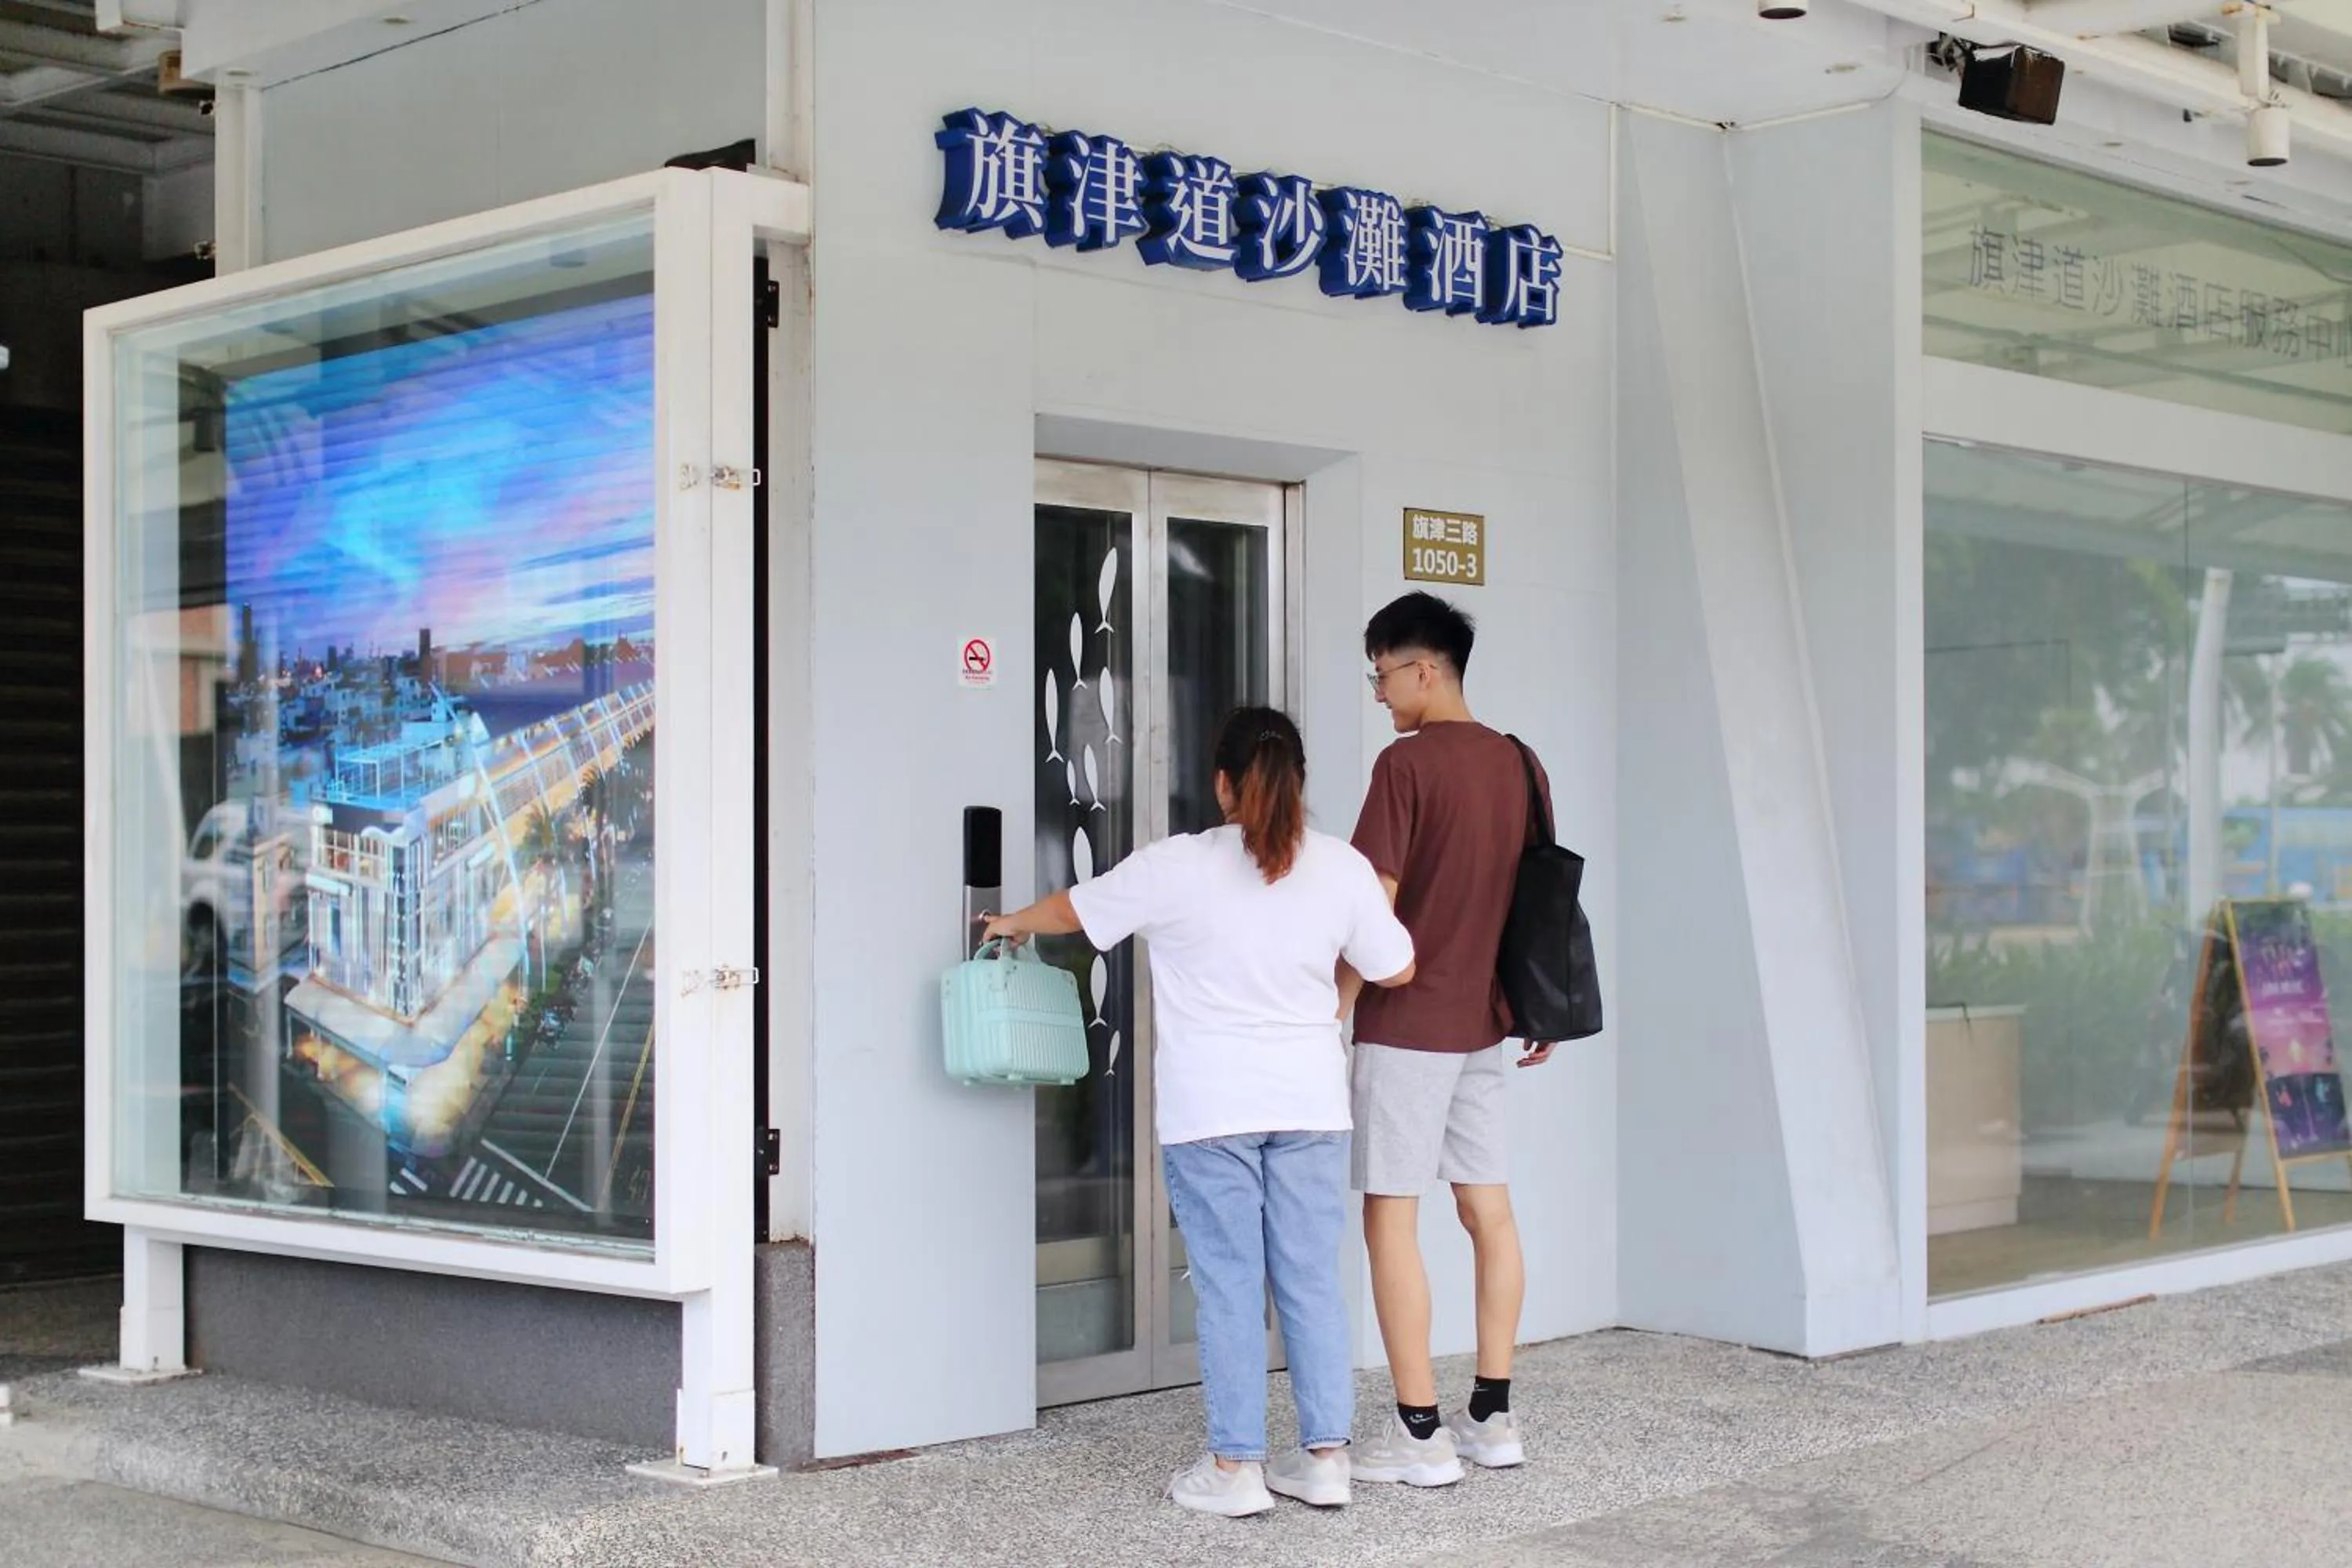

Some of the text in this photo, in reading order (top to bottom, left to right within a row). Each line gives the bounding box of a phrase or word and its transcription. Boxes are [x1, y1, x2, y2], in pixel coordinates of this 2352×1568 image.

[953, 110, 1563, 326] 旗津道沙灘酒店
[1413, 514, 1478, 546] 旗津三路
[1412, 547, 1477, 578] 1050-3
